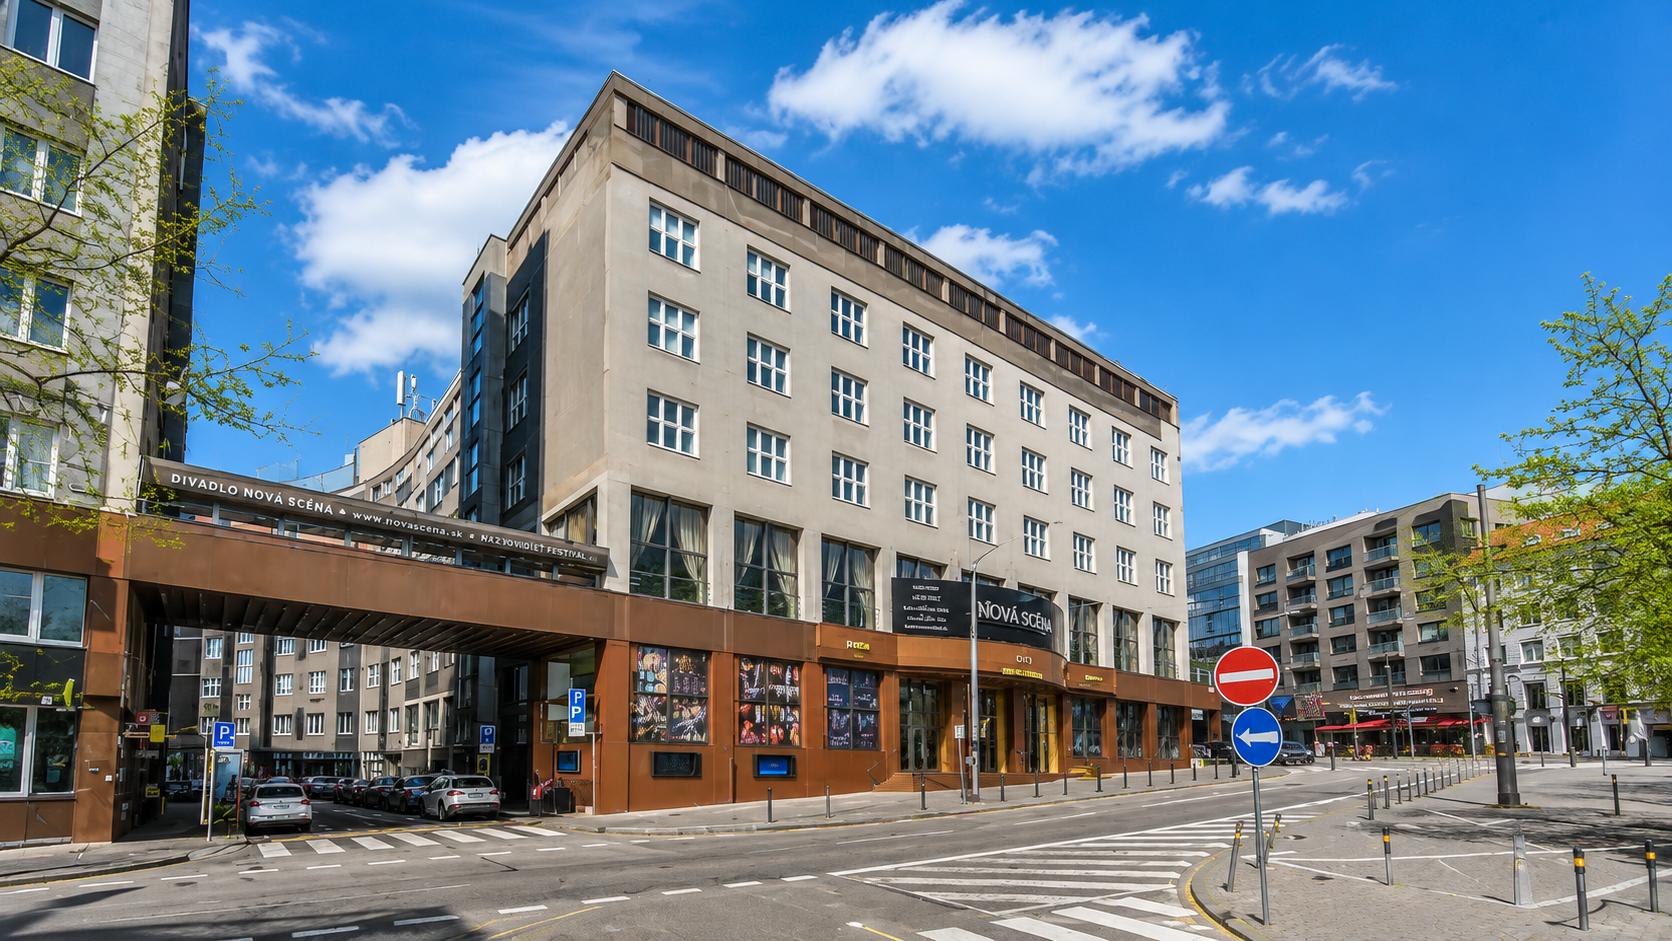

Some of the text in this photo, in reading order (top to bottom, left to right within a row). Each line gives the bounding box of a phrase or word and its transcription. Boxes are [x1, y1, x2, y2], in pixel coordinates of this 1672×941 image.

[170, 473, 238, 496] DIVADLO
[243, 487, 284, 505] NOVÁ
[288, 496, 334, 516] SCÉNA
[352, 512, 463, 538] www.novascena.sk
[977, 600, 1020, 625] NOVÁ
[574, 691, 583, 704] P
[571, 706, 582, 719] P
[219, 725, 230, 740] P
